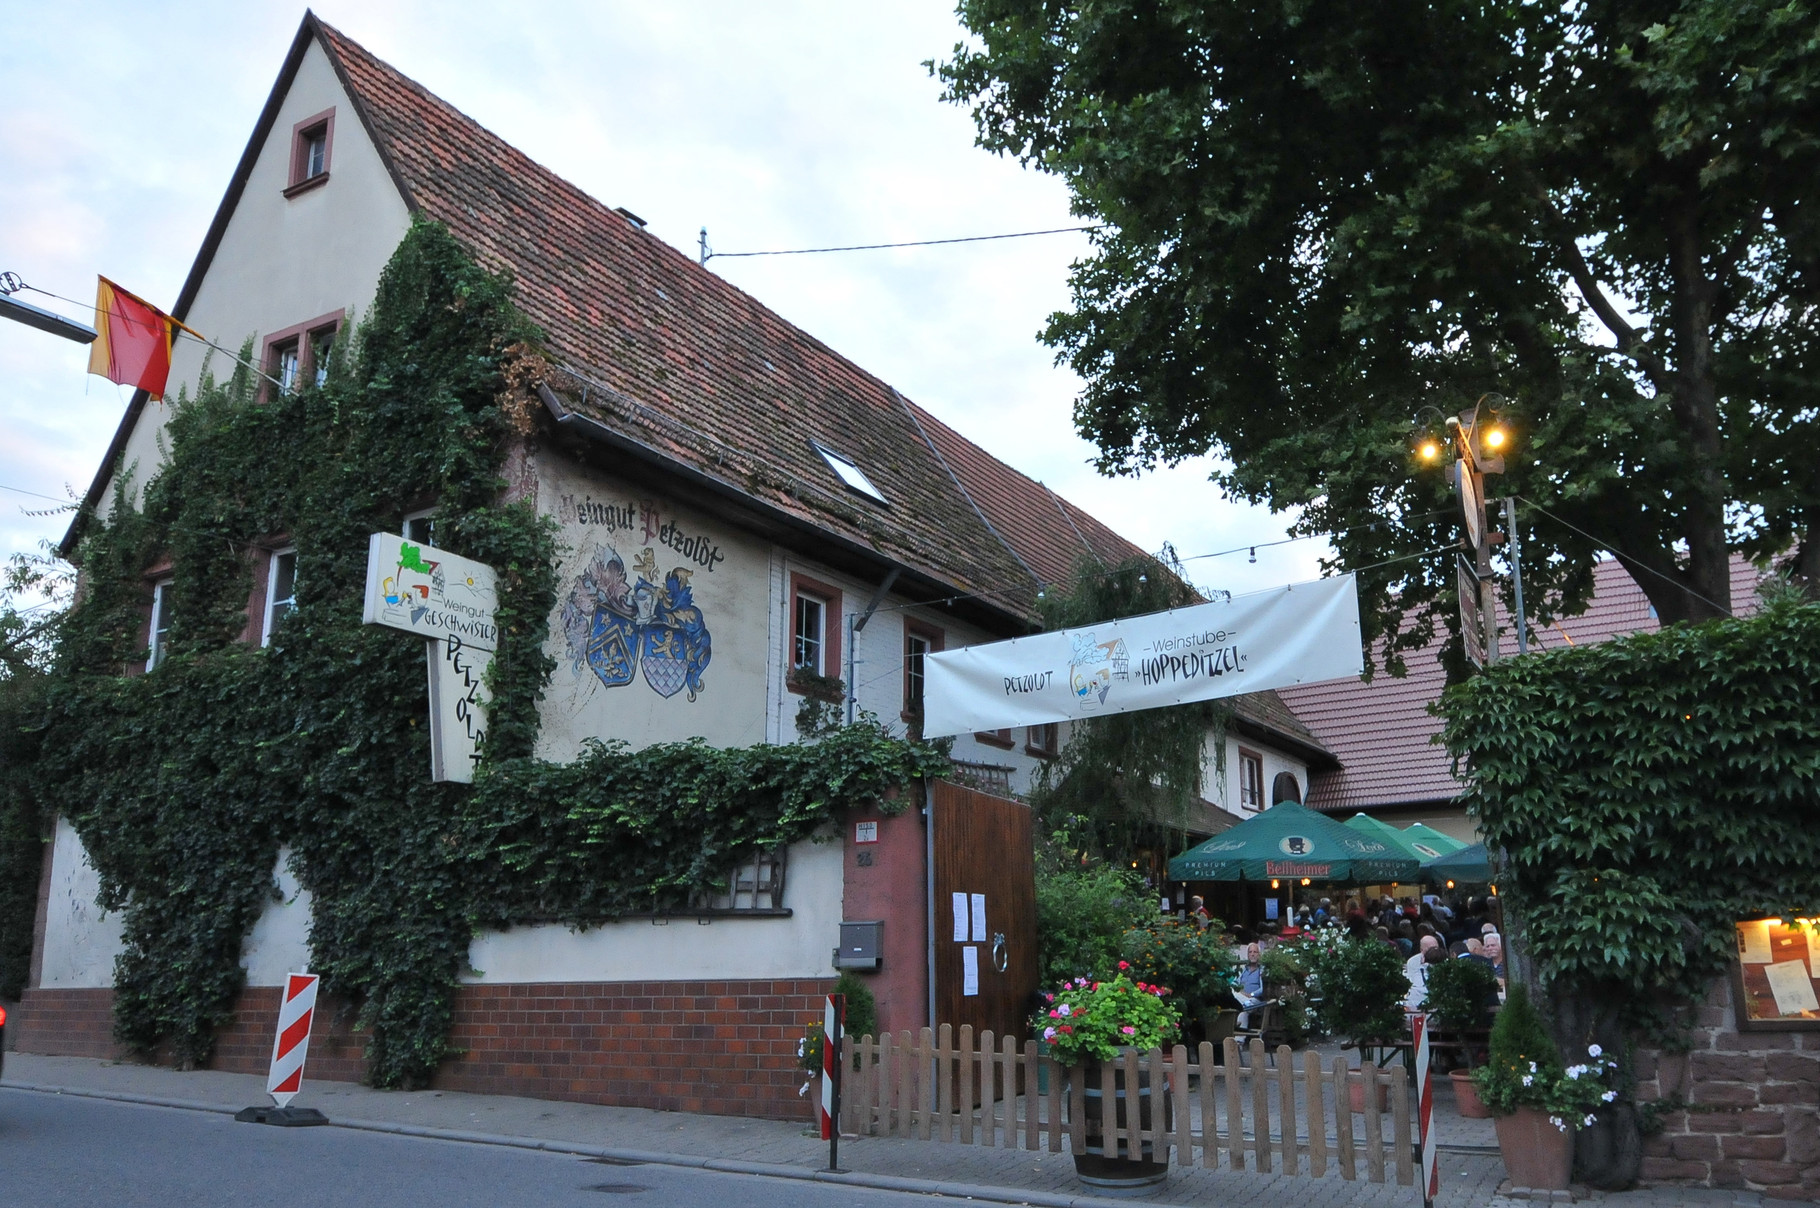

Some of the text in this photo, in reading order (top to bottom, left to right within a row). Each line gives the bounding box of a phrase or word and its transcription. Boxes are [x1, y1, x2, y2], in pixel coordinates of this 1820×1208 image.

[640, 499, 724, 573] Petzoldt
[443, 598, 485, 619] Weingut
[1003, 670, 1054, 696] PETZOLDT
[1184, 861, 1227, 870] PREMIUM
[1265, 860, 1332, 876] Bellheimer
